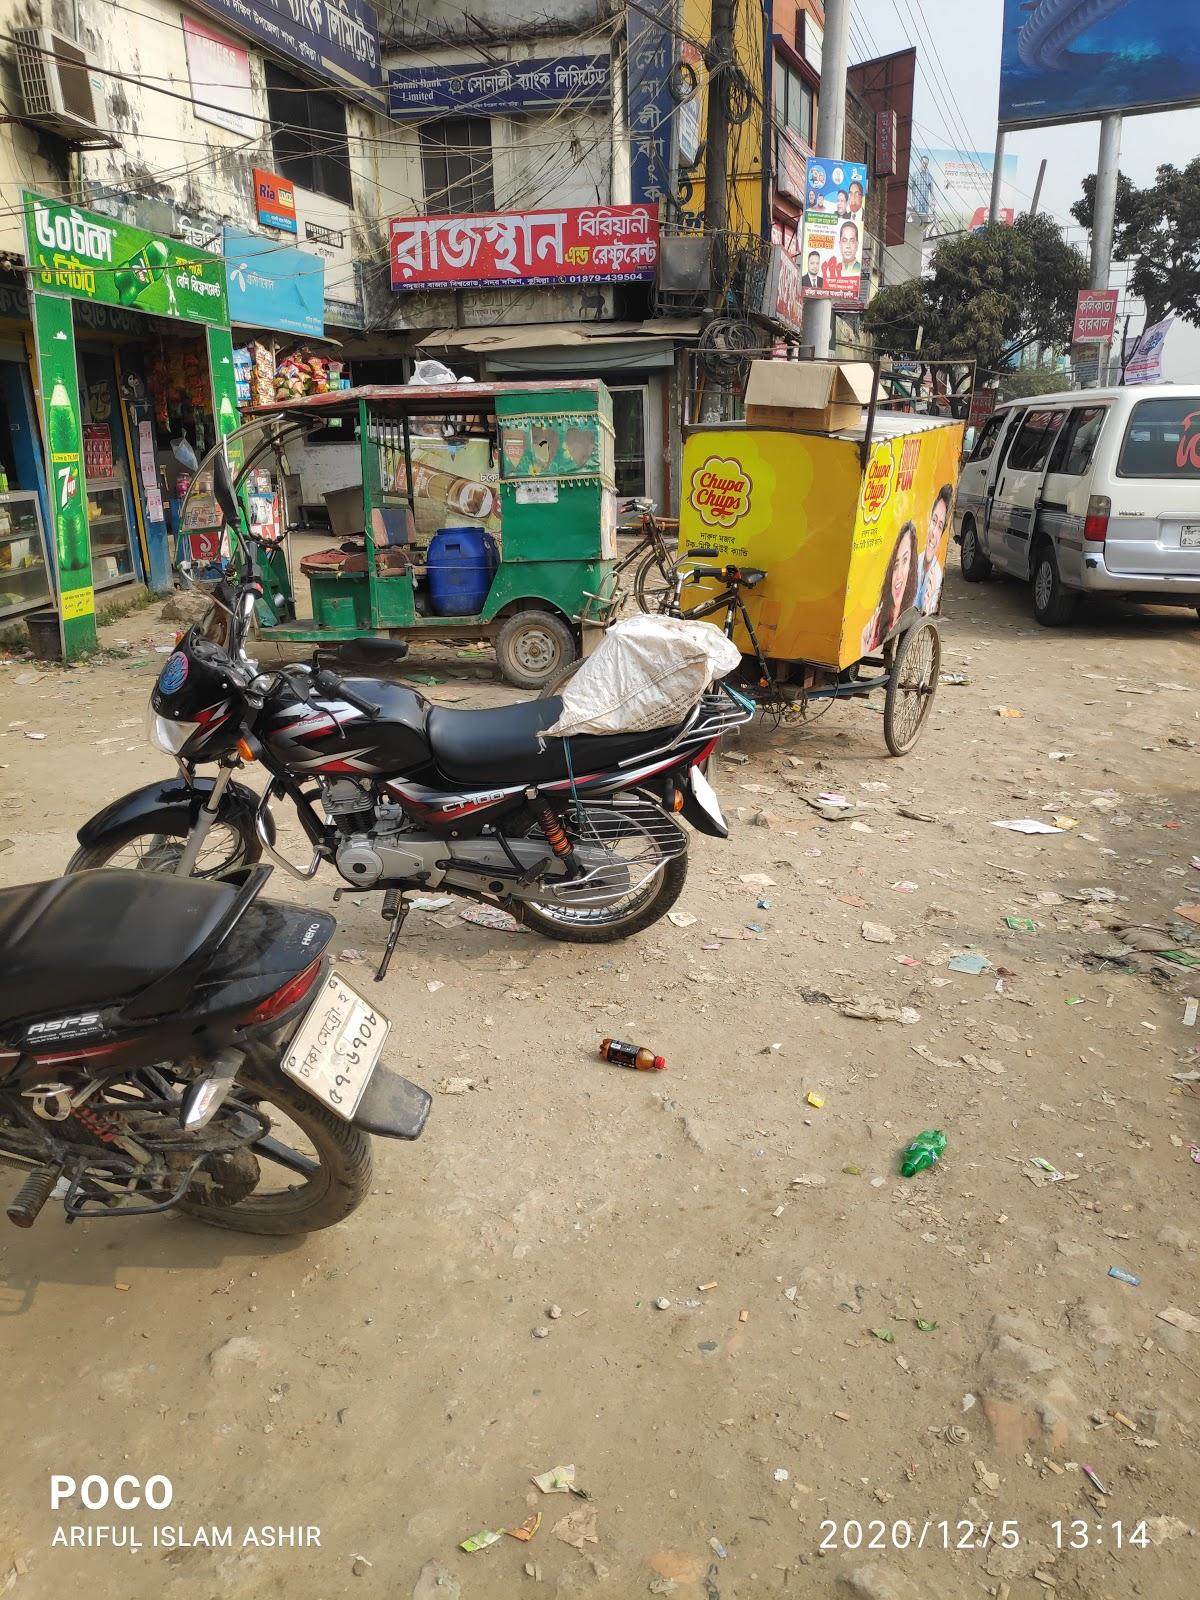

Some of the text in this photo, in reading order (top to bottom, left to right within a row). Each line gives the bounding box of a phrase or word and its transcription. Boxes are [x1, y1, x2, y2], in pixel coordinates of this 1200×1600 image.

[393, 77, 442, 90] Sonali Bank
[467, 65, 606, 93] সোনালী ব্যাংক লিমিটেড
[402, 91, 434, 102] Limited
[259, 183, 275, 201] Ria
[577, 208, 649, 236] বিরিয়ানী
[393, 213, 567, 279] রাজস্থান
[565, 246, 591, 266] এন্ড
[53, 253, 96, 298] লিটার
[569, 273, 643, 283] 01879-439504
[1079, 296, 1114, 313] কলিকাতা
[1078, 317, 1112, 332] হারবাল
[868, 460, 891, 482] Chupa
[895, 472, 913, 492] FUN
[700, 472, 745, 494] Chupa
[696, 488, 741, 517] Chups
[864, 481, 887, 512] Chups
[719, 535, 736, 544] মজার
[442, 791, 505, 813] CT100
[302, 923, 320, 946] Hero
[27, 1014, 100, 1036] ASFS
[300, 1044, 322, 1077] ঢাকা
[329, 1011, 377, 1104] ৫৭-৬৭০৮
